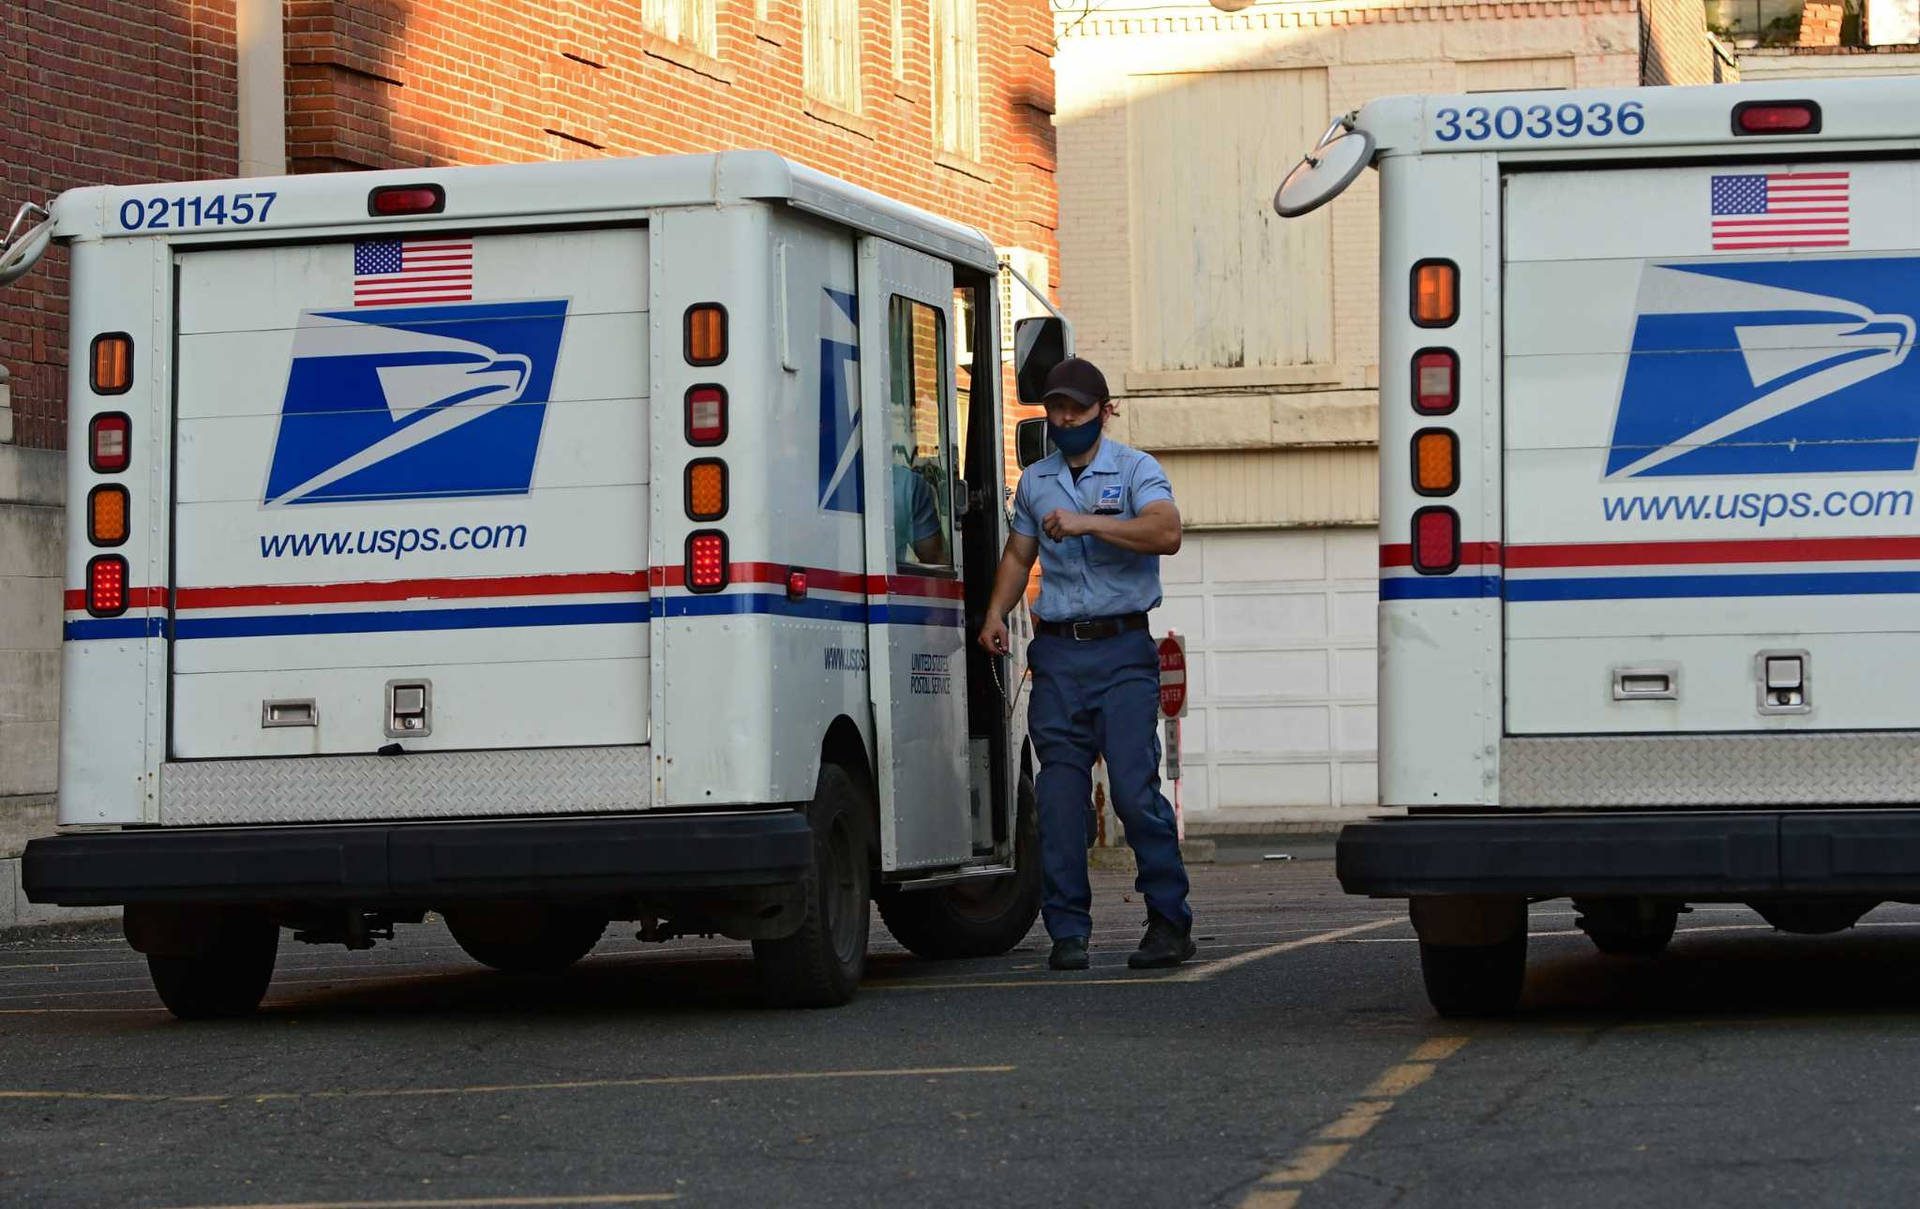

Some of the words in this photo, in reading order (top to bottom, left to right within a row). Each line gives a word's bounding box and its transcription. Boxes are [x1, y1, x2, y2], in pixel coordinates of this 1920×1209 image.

[1435, 101, 1645, 141] 3303936
[120, 192, 277, 230] 0211457
[1603, 490, 1914, 527] www.usps.com
[260, 523, 527, 559] www.usps.com
[911, 653, 931, 671] UNITED
[932, 655, 949, 672] STATES
[1168, 653, 1181, 665] NOT
[911, 676, 930, 694] POSTAL
[932, 677, 951, 694] SERVICE
[1161, 689, 1181, 703] ENTER
